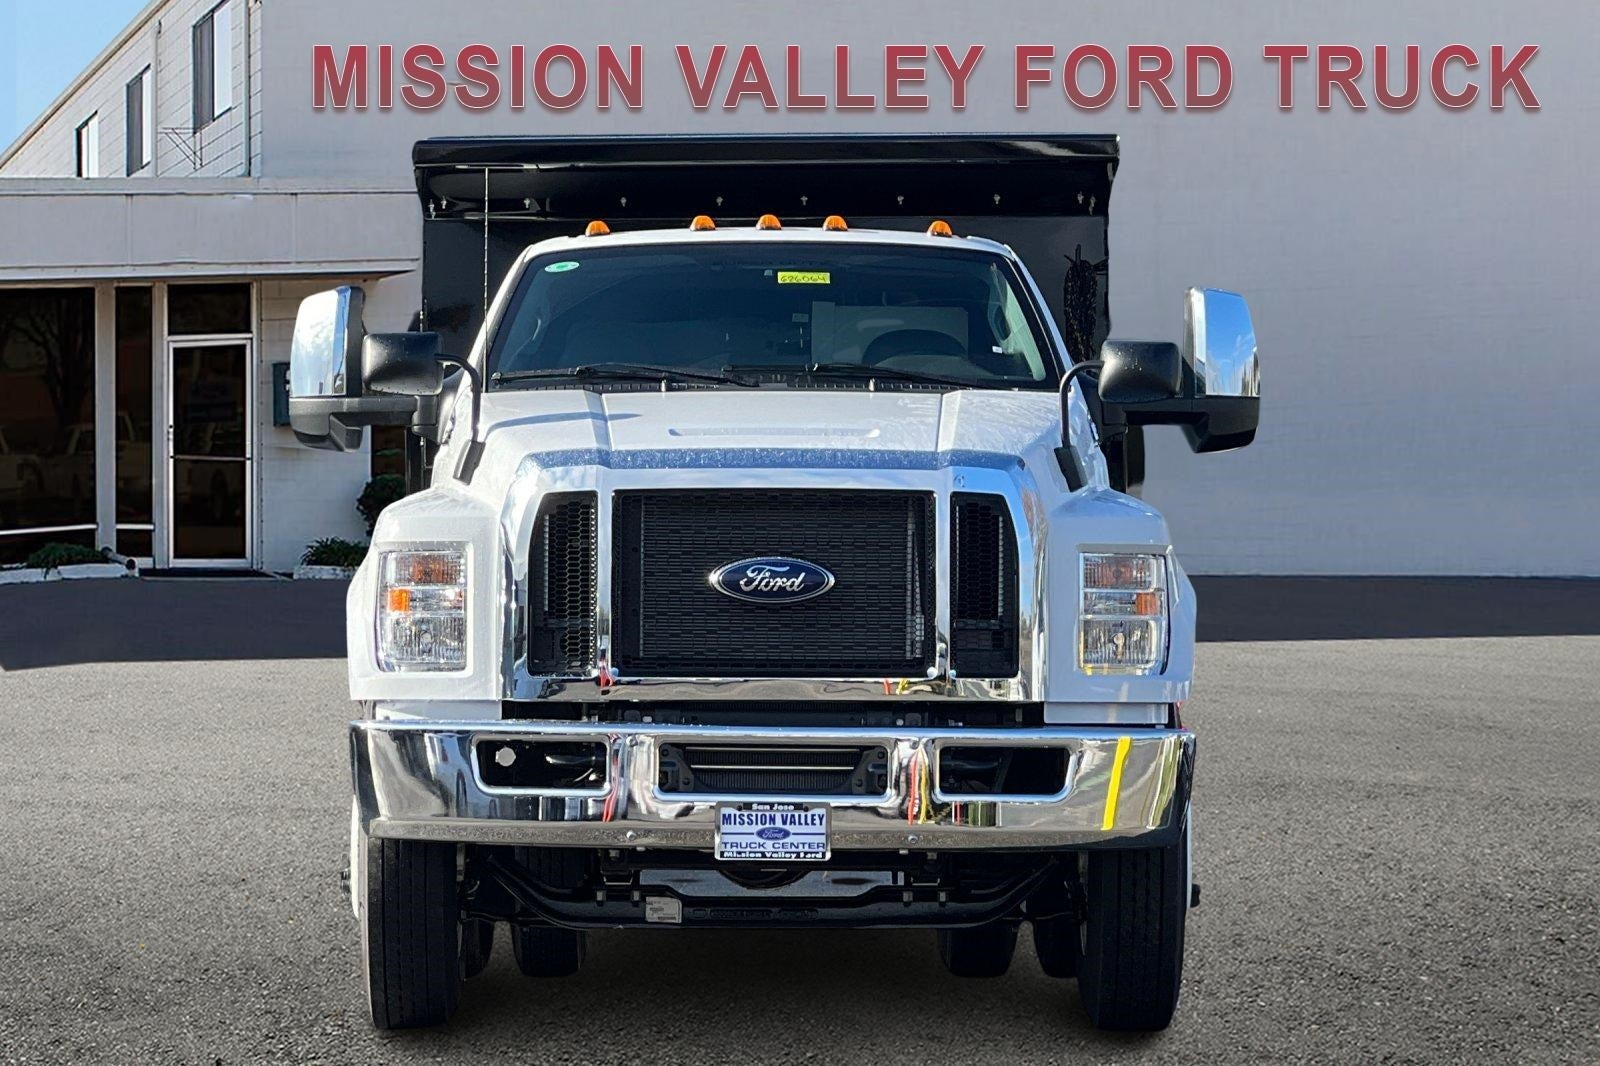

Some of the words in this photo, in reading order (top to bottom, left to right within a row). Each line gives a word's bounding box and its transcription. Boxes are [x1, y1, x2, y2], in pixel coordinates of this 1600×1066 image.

[740, 565, 805, 592] Ford
[722, 813, 776, 826] MISSION
[781, 813, 825, 826] VALLEY
[762, 829, 785, 838] Ford
[722, 842, 767, 850] TRUCK
[772, 842, 826, 850] CENTER
[764, 851, 797, 859] Valley
